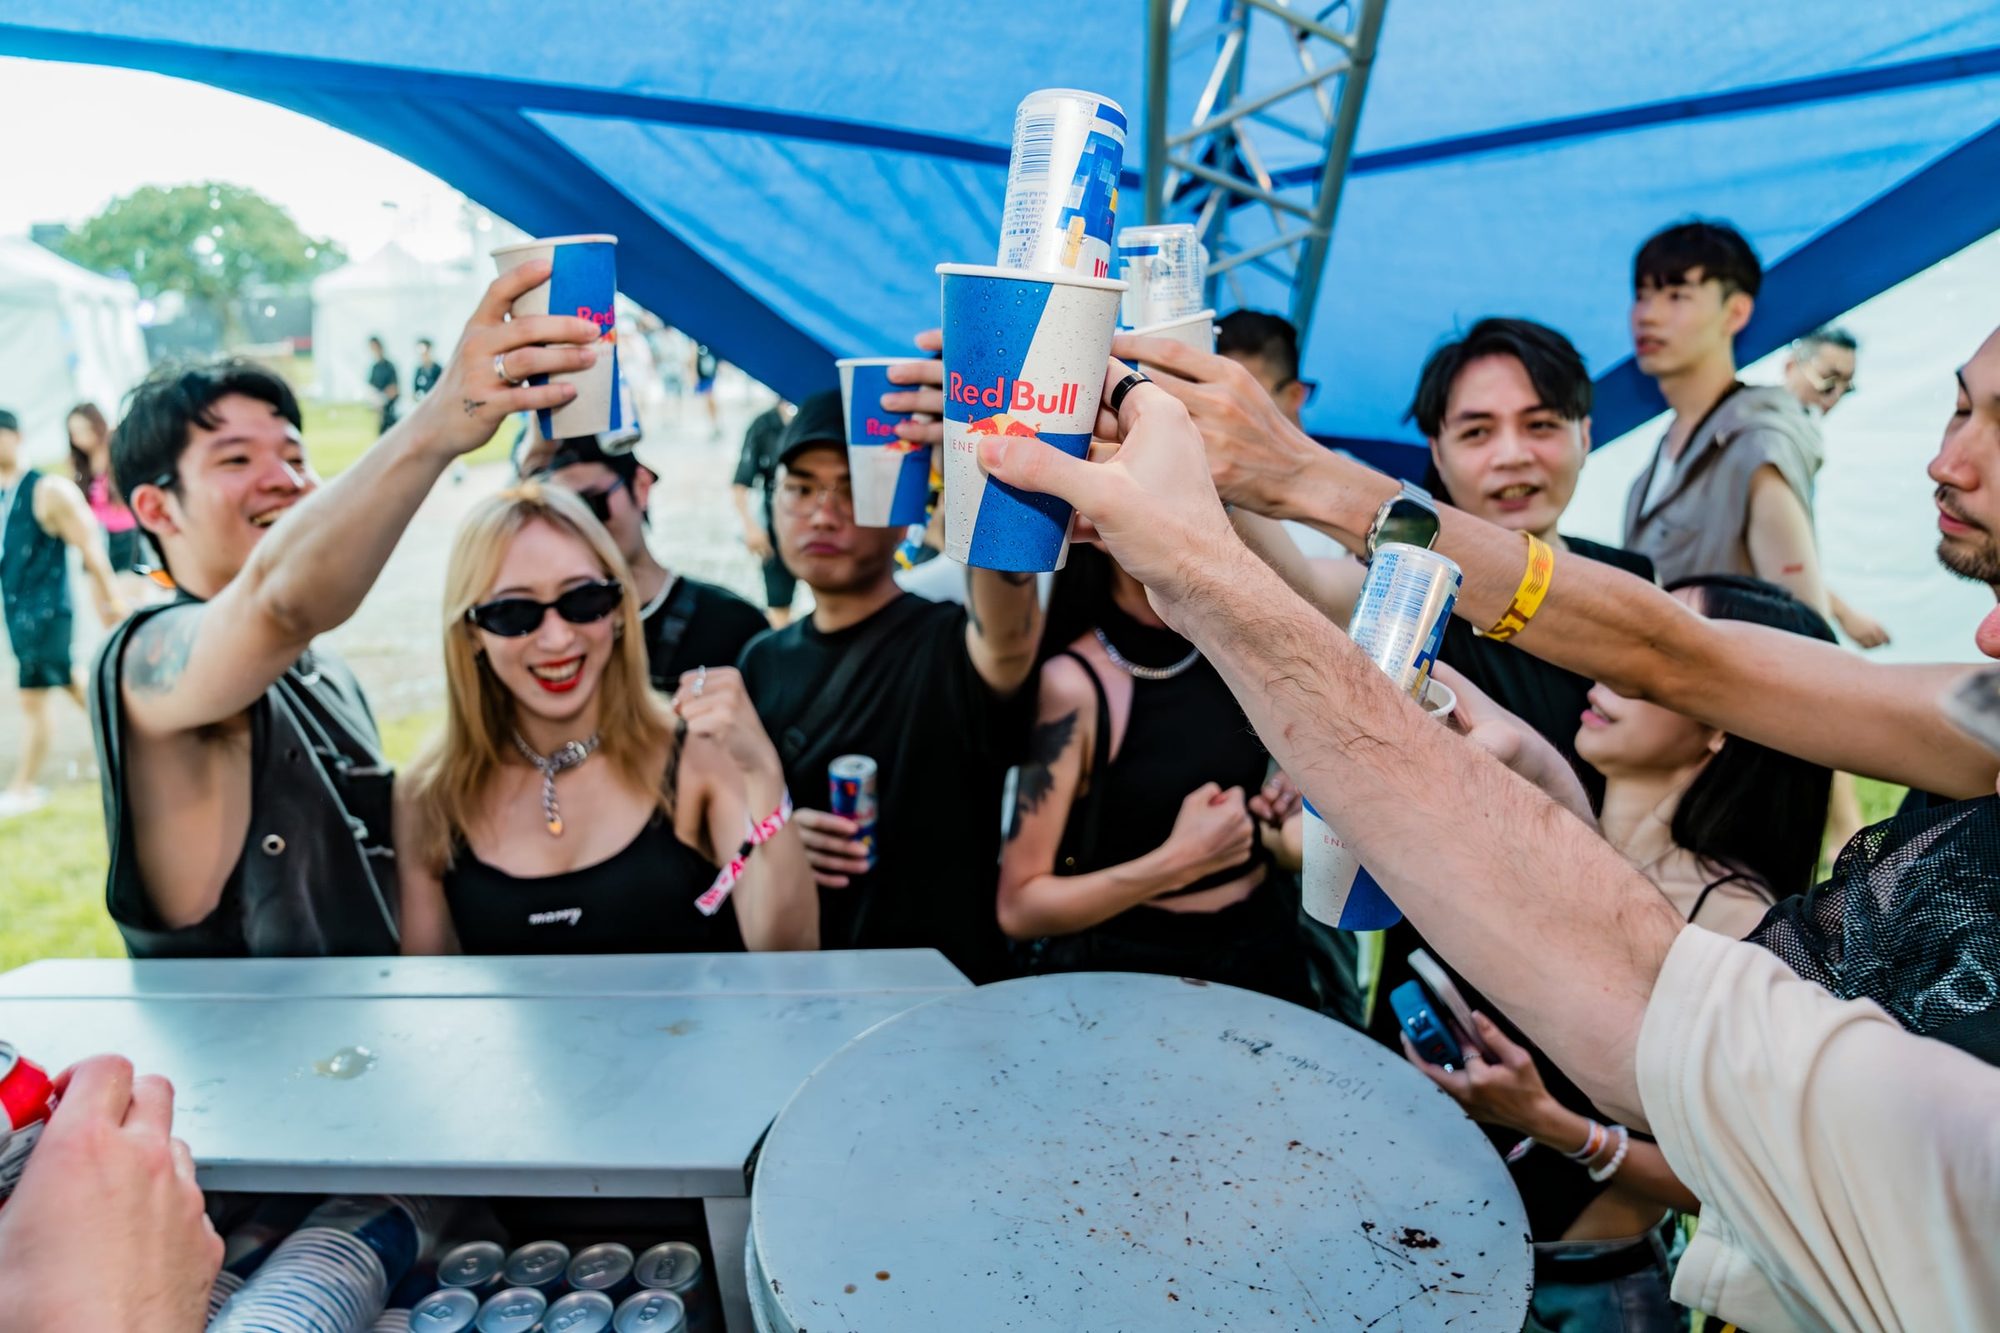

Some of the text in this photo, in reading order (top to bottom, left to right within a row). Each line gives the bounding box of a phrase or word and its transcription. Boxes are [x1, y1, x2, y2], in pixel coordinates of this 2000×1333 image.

[950, 371, 1079, 415] Red Bull
[866, 418, 905, 436] Re
[951, 439, 974, 453] ENE
